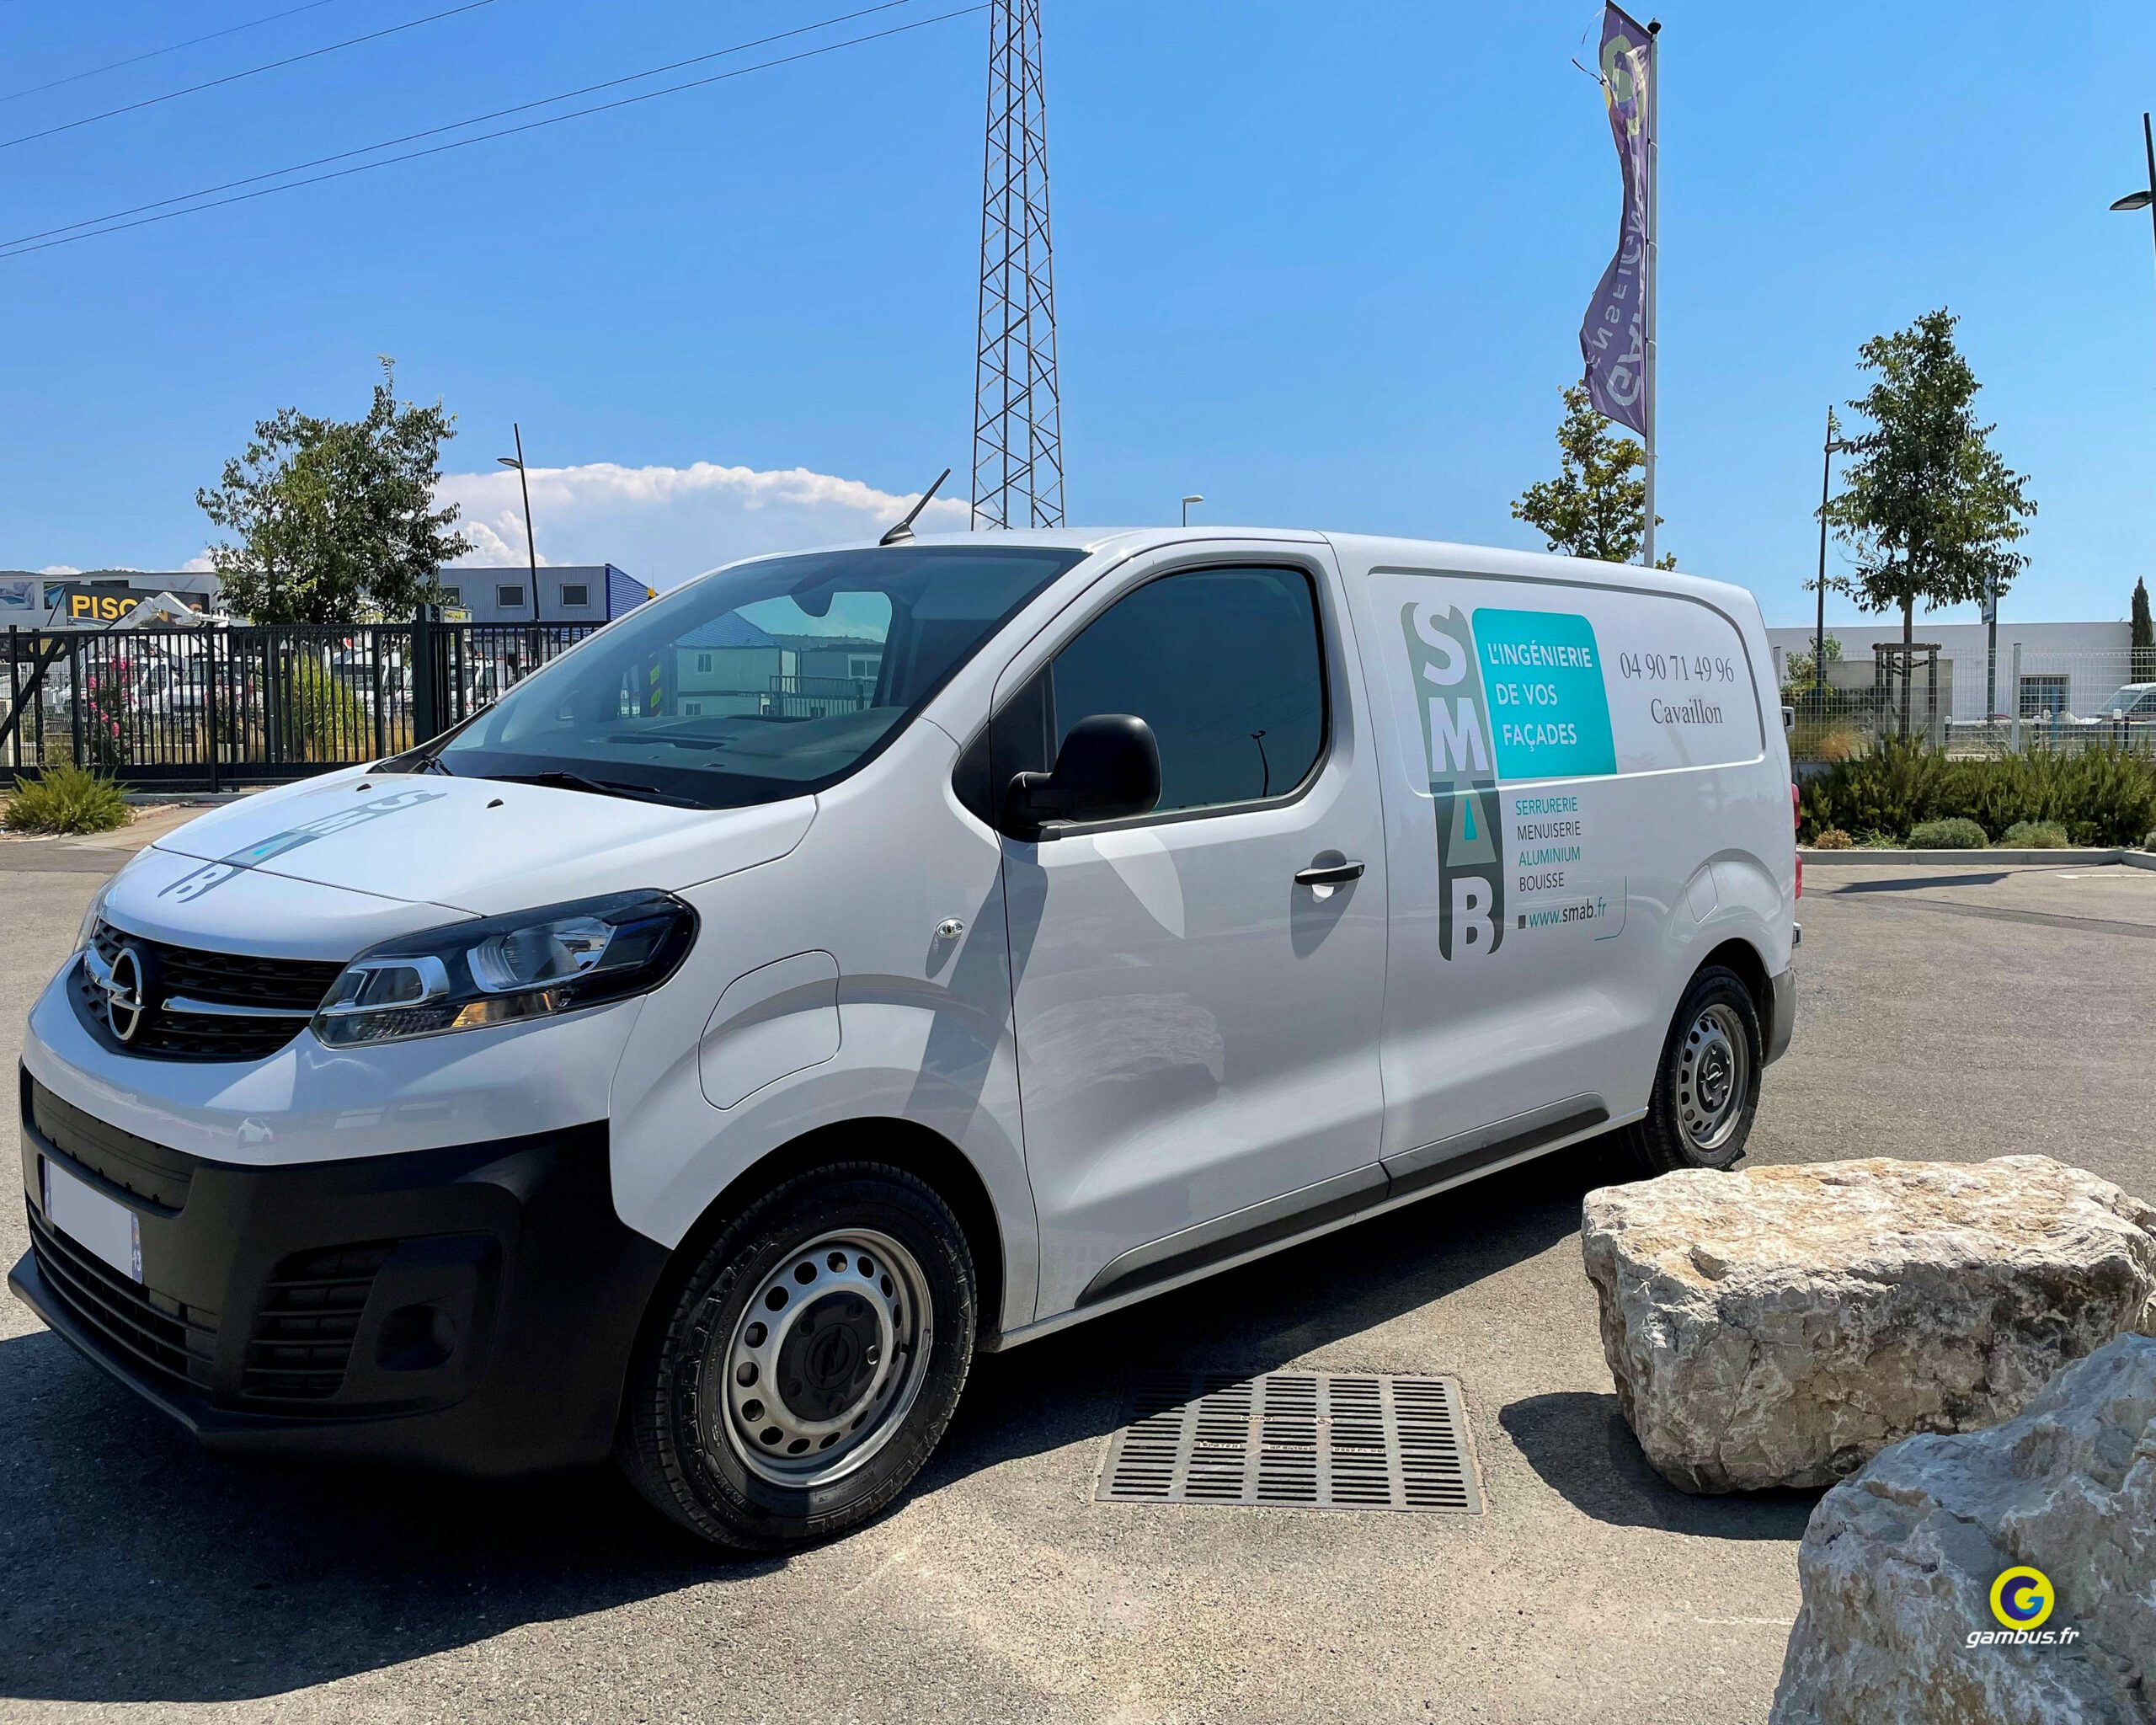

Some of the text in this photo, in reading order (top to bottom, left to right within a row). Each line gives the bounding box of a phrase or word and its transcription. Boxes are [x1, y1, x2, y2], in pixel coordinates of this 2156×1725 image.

[1487, 640, 1593, 668] L'INGÉNIERIE
[1620, 652, 1734, 682] 04 90 71 49 96
[1496, 684, 1558, 706] DE VOS
[1651, 698, 1724, 724] Cavaillon
[1502, 723, 1577, 752] FAÇADES
[1408, 601, 1499, 961] SMAB
[1516, 797, 1578, 816] SERRURERIE
[1518, 821, 1581, 841] MENUISERIE
[1518, 846, 1581, 867] ALUMINIUM
[1519, 872, 1565, 892] BOUISSE
[1529, 896, 1607, 928] www.smab.fr
